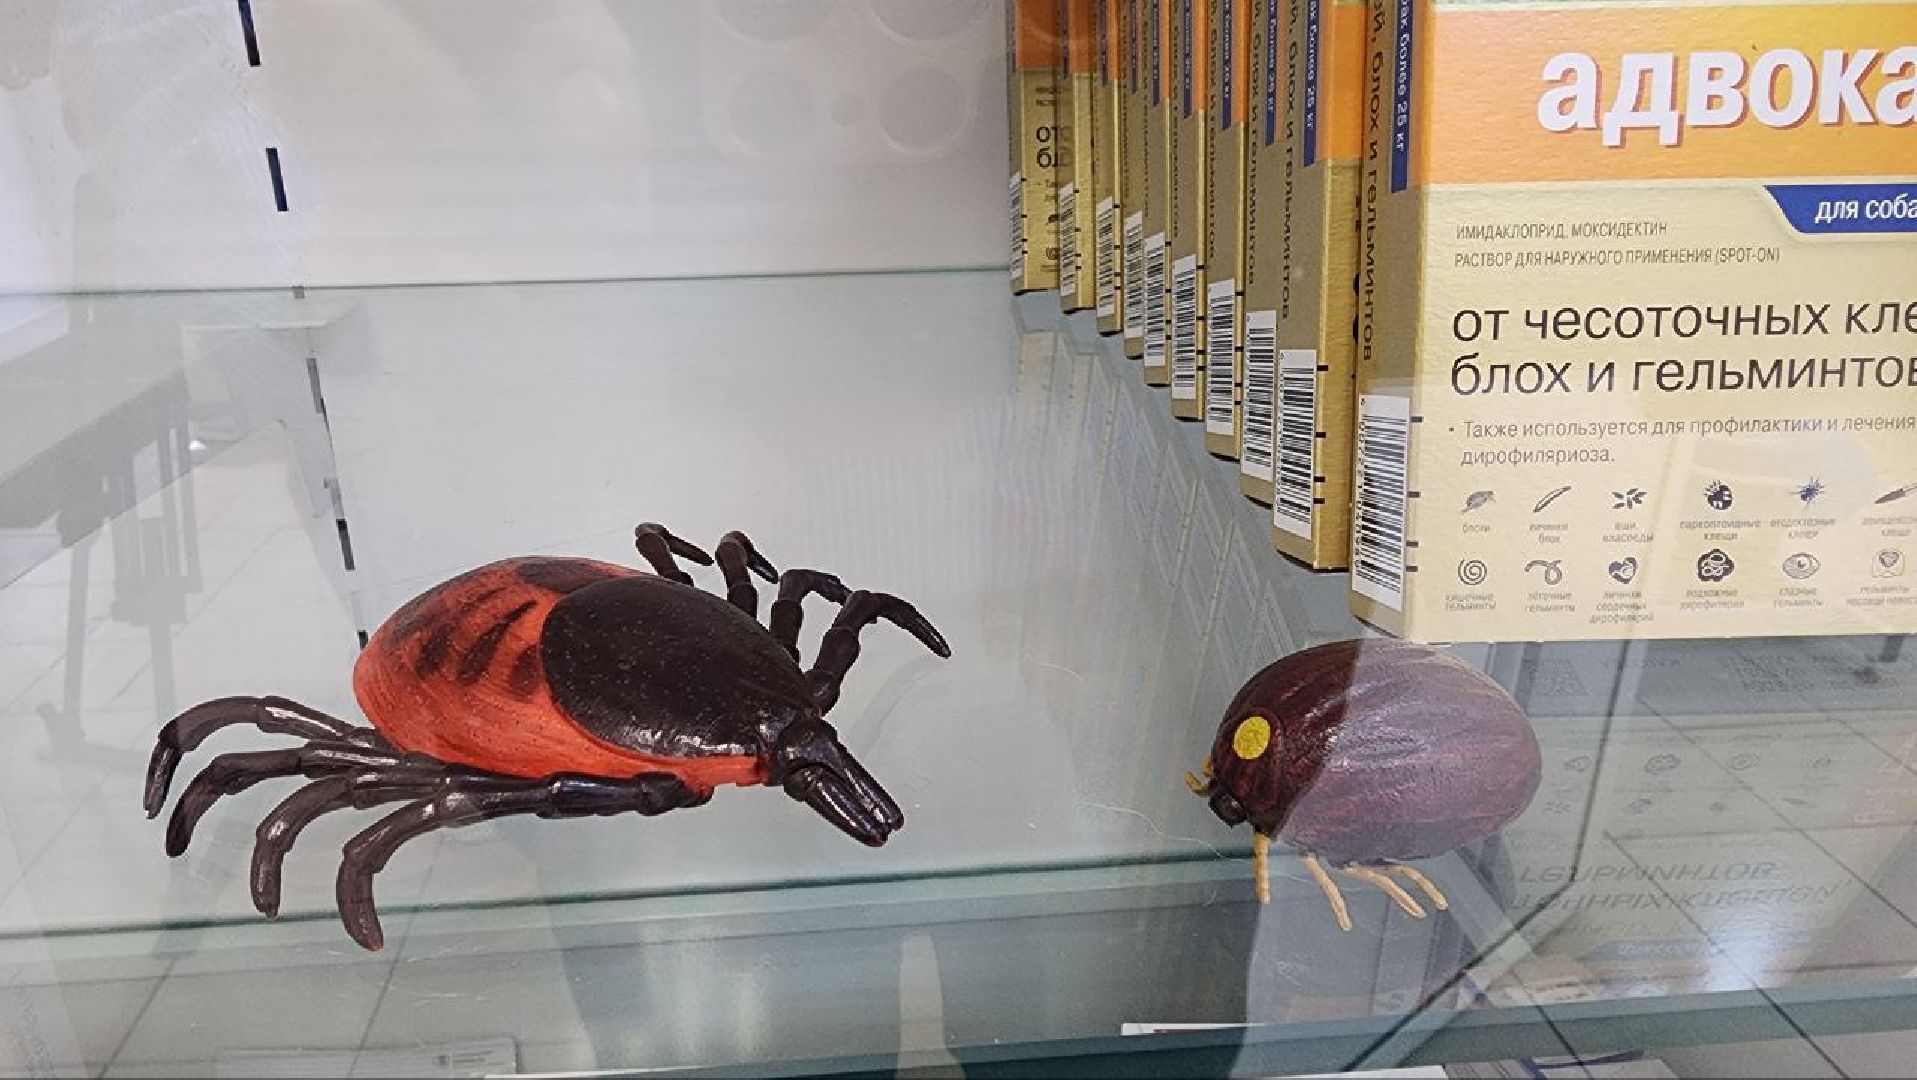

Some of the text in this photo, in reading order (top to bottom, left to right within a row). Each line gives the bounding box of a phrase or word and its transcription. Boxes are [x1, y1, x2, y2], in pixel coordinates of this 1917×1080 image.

[1398, 33, 1410, 96] более
[1370, 52, 1384, 133] блох
[1537, 45, 1917, 148] адвока
[1396, 101, 1408, 126] 25
[1369, 139, 1378, 161] и
[1396, 132, 1404, 152] кг
[1815, 192, 1917, 224] для соба
[1282, 147, 1293, 319] гельминтов
[1571, 221, 1667, 239] МОКСИДЕКТИН
[1363, 169, 1377, 361] гельминтов
[1455, 247, 1780, 268] РАСТВОР ДЛЯ НАРУЖНОГО ПРИМЕНЕНИЯ (SPOT-ON)
[1453, 309, 1509, 341] от
[1525, 303, 1831, 340] чесоточных
[1451, 352, 1572, 395] блох
[1586, 361, 1615, 393] и
[1463, 416, 1916, 439] Также используется для профилактики и лечения
[1460, 448, 1615, 467] дирофиляриоза.
